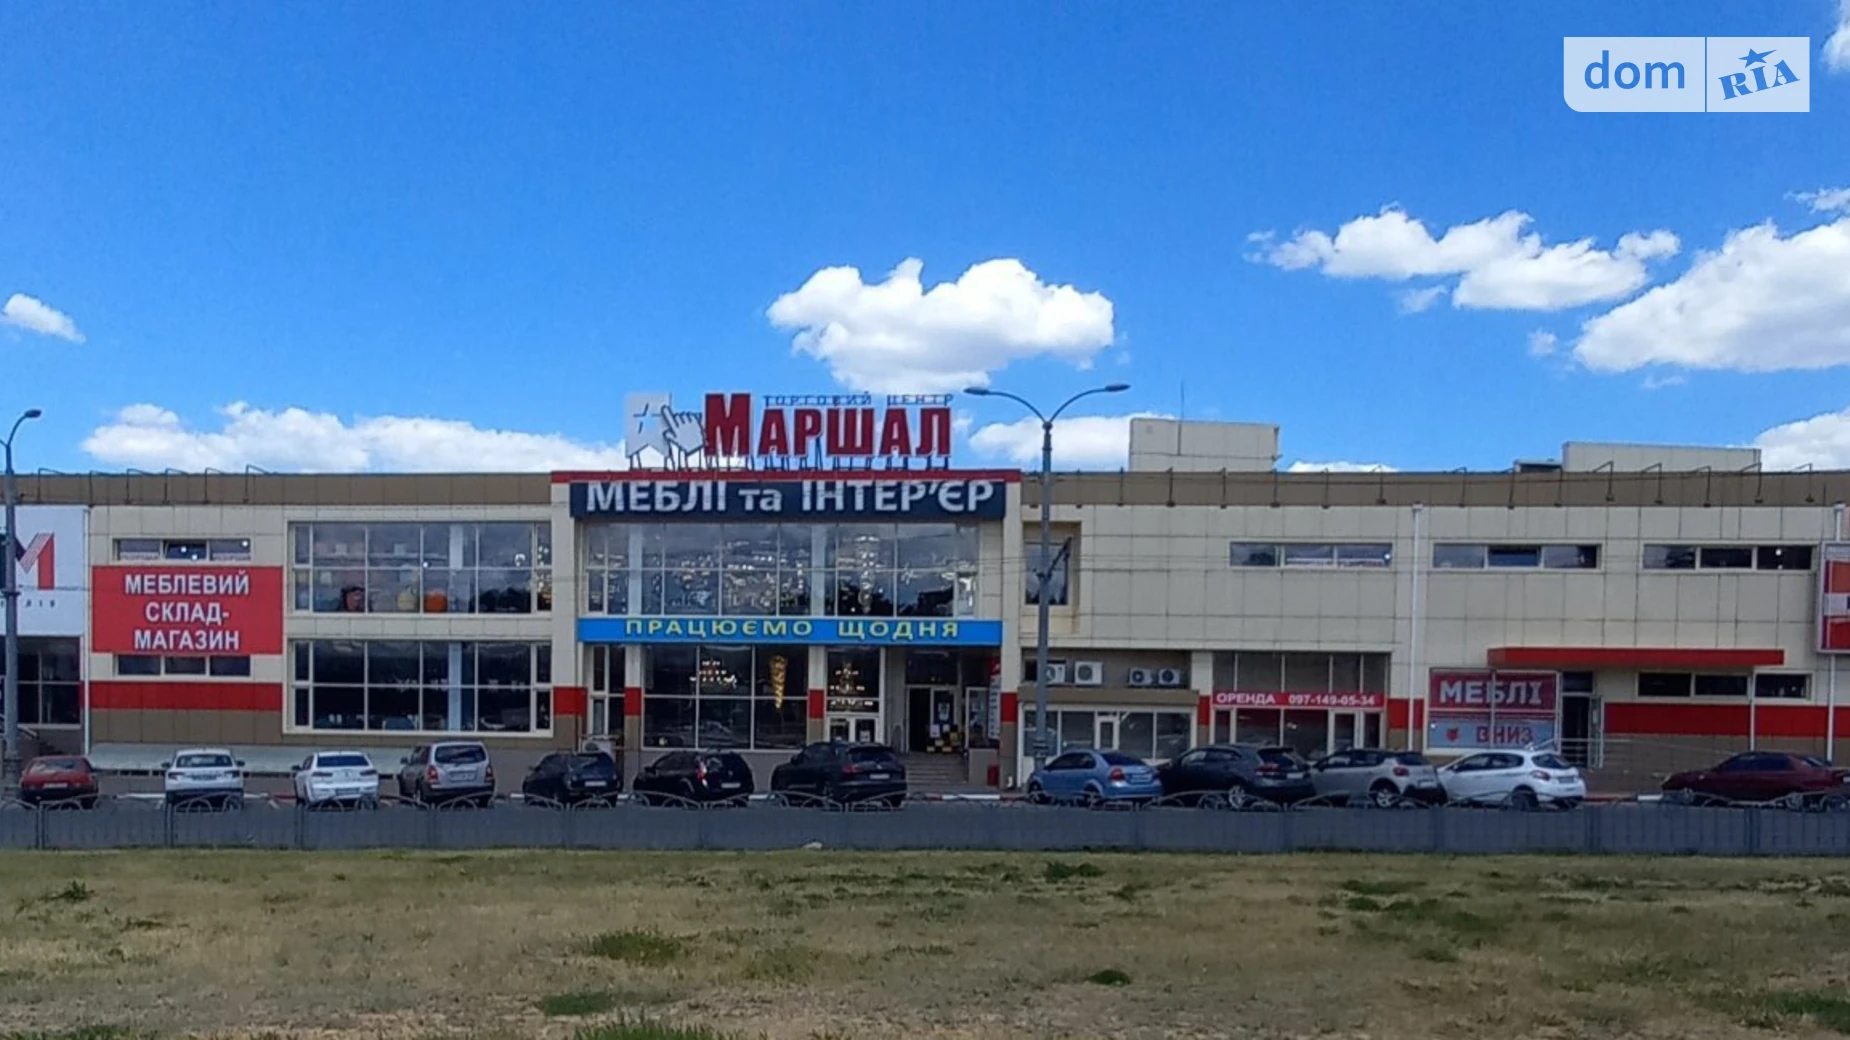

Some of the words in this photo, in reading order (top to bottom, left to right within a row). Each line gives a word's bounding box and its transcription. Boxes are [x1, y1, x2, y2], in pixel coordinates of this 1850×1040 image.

[763, 391, 872, 406] ТОРГОВИЙ
[887, 393, 954, 406] ЦЕНТР
[586, 480, 726, 511] МЕБЛІ
[125, 570, 249, 595] МЕБЛЕВИЙ
[145, 602, 230, 625] СКЛАД-
[134, 630, 239, 650] МАГАЗИН
[625, 619, 813, 638] ПРАЦЮЄМО
[838, 620, 959, 640] ЩОДНЯ
[1216, 692, 1276, 705] ОРЕНДА
[1440, 680, 1542, 704] МЕБЛІ
[1476, 726, 1533, 745] ВНИЗ
